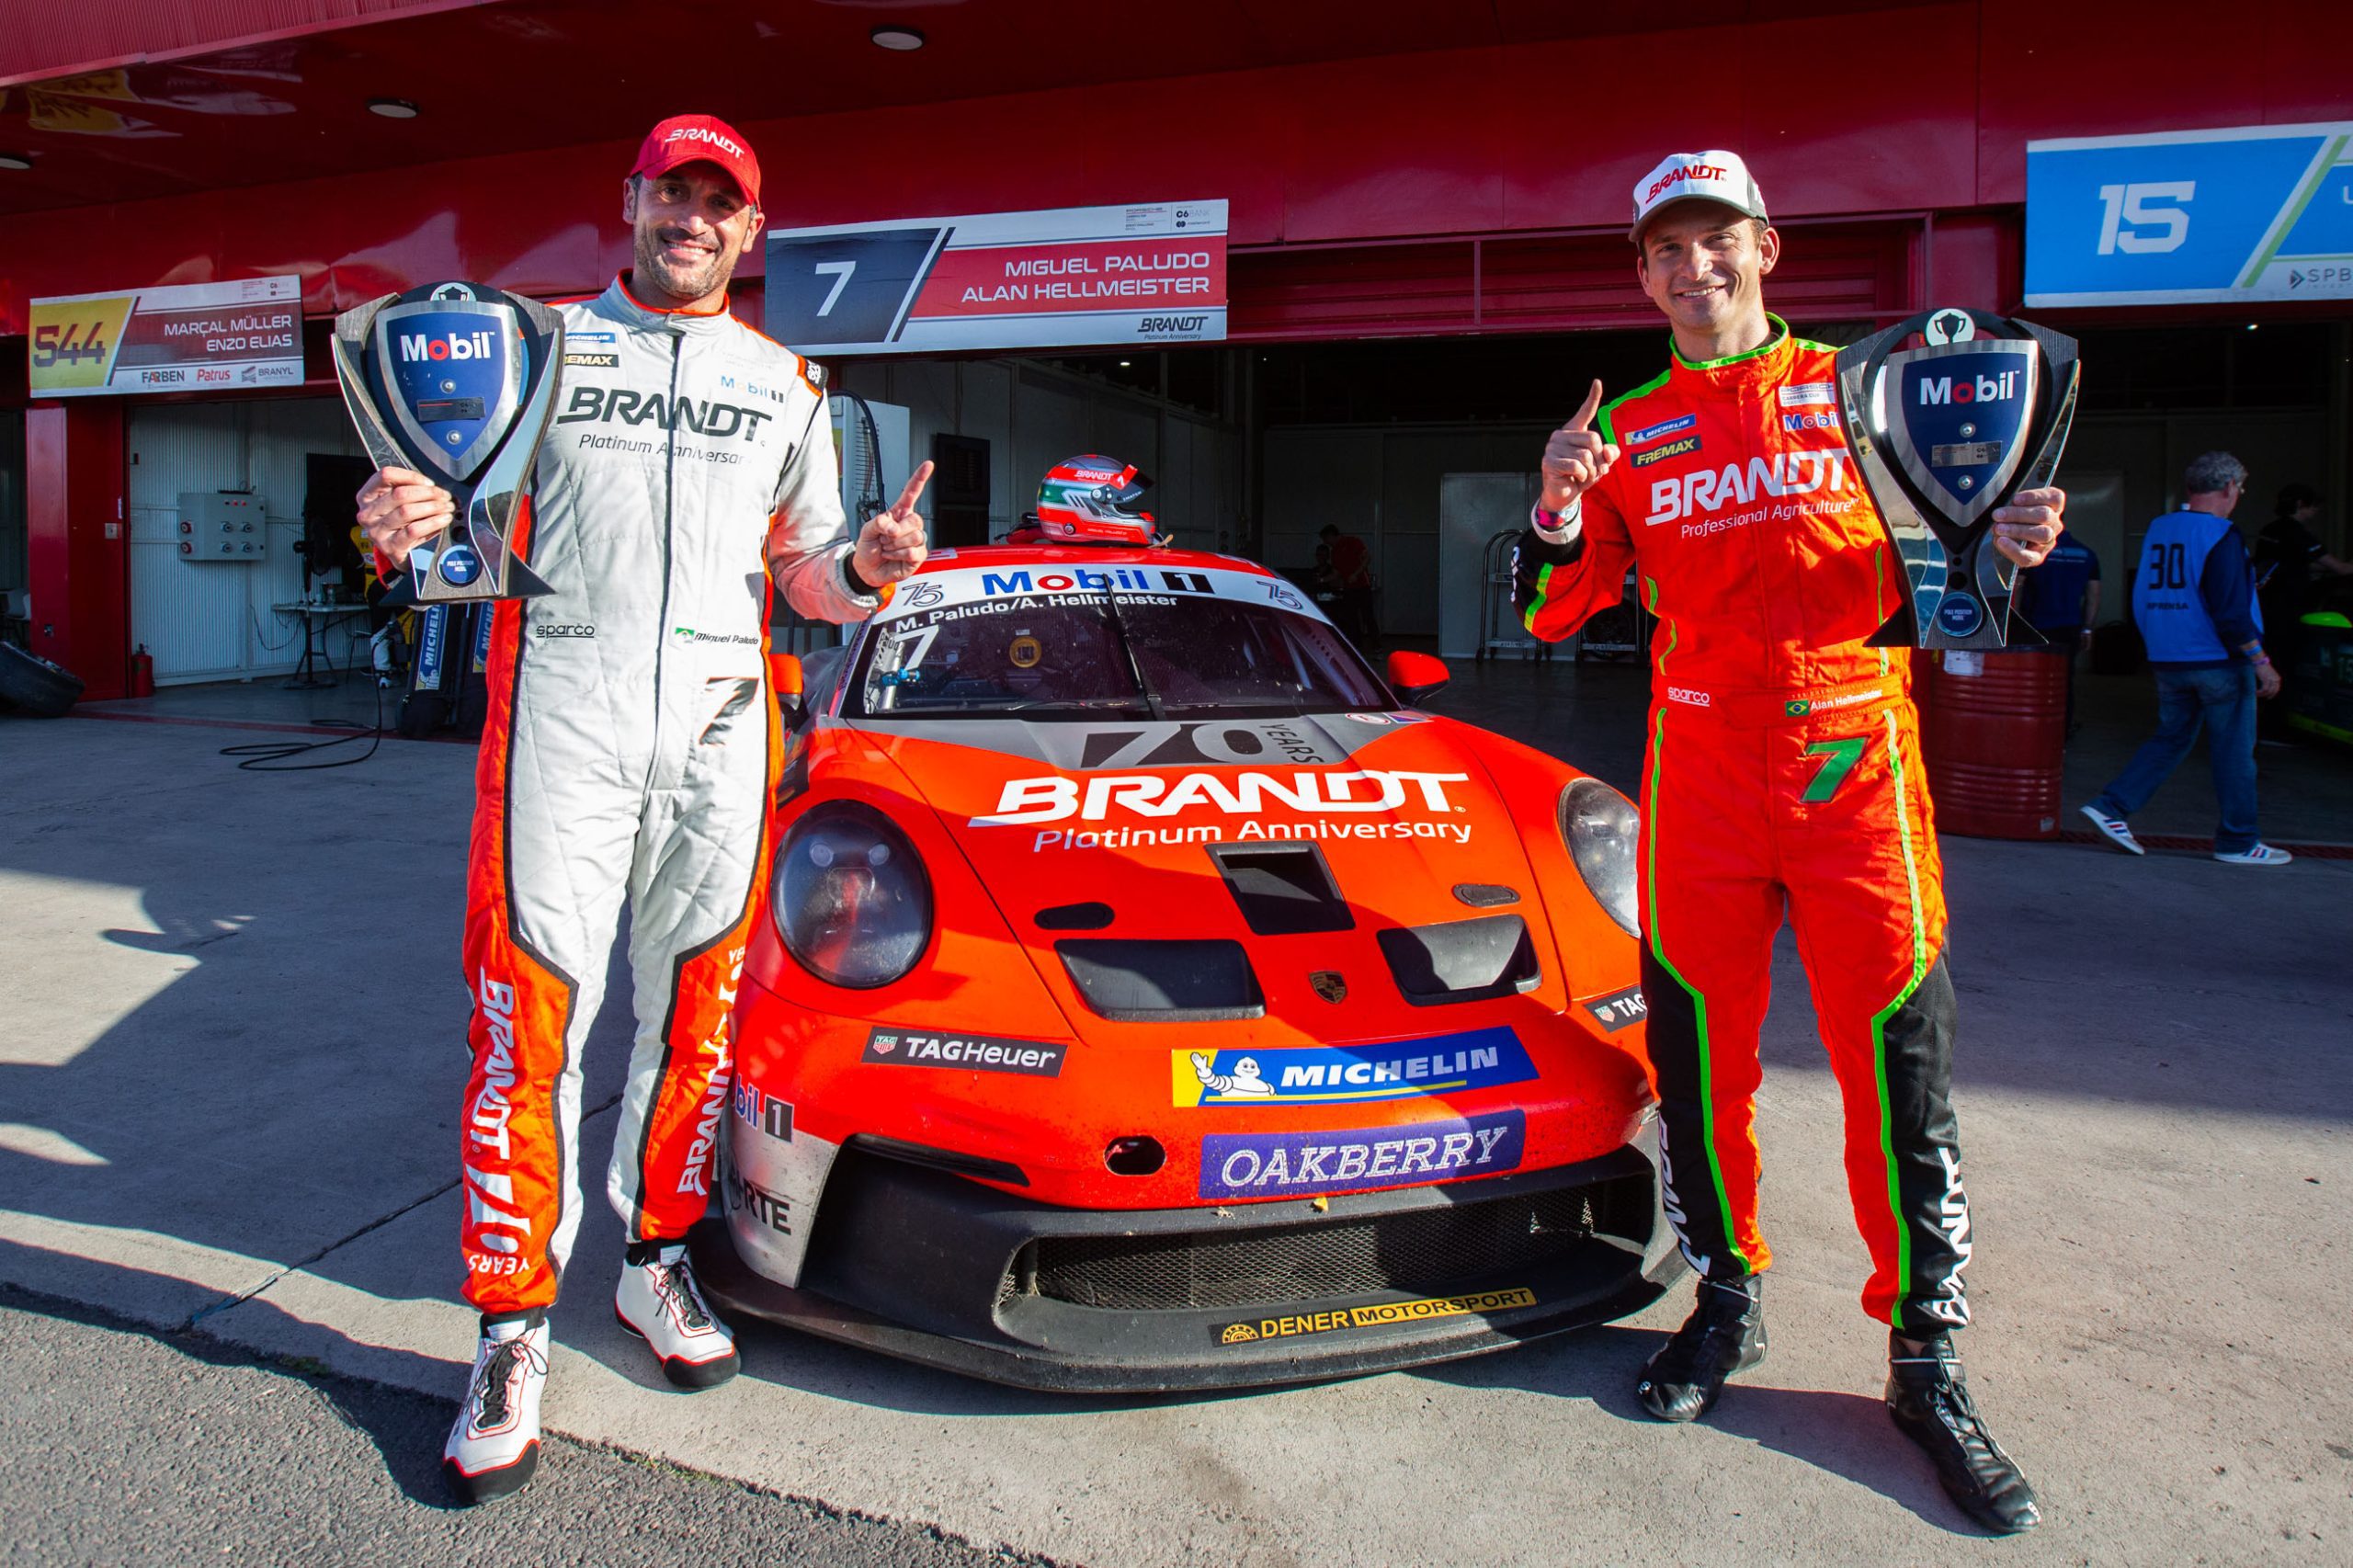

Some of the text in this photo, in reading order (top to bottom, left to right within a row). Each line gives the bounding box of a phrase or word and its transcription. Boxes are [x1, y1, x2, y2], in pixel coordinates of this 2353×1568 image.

[665, 129, 745, 158] BRANDT
[1646, 165, 1726, 204] BRANDT
[2097, 180, 2196, 256] 15
[1006, 251, 1210, 278] MIGUEL PALUDO
[815, 260, 856, 317] 7
[961, 277, 1210, 303] ALAN HELLMEISTER
[165, 314, 291, 337] MARÇAL MÜLLER
[1138, 316, 1209, 332] BRANDT
[33, 322, 107, 368] 544
[207, 334, 292, 352] ENZO ELIAS
[400, 332, 492, 362] Mobil
[142, 369, 185, 383] FARBEN
[197, 369, 231, 381] Patrus
[258, 367, 293, 377] BRANYL
[721, 375, 767, 397] Mobil
[1920, 370, 2014, 405] Mobil
[557, 386, 772, 441] BRANDT
[1646, 419, 1689, 438] MICHELIN
[579, 434, 653, 454] Platinum
[1637, 438, 1695, 466] FREMAX
[1074, 470, 1113, 481] BRANDT
[1645, 448, 1850, 527] BRANDT
[1681, 500, 1852, 539] Professional Agriculture
[2148, 543, 2185, 590] 30
[902, 582, 944, 608] 75
[982, 569, 1151, 597] Mobil
[1256, 581, 1303, 610] 75
[425, 604, 441, 666] MICHELI
[536, 624, 595, 638] sparco
[895, 617, 923, 633] M.
[894, 625, 939, 670] 7
[699, 676, 759, 745] 7
[1667, 686, 1710, 706] sparco
[1811, 700, 1833, 710] Alan
[1259, 724, 1324, 764] YEARS
[1800, 735, 1870, 802] 7
[967, 770, 1469, 827] BRANDT
[1033, 818, 1472, 853] Platinum Anniversary
[469, 967, 515, 1161] BRANDT
[1281, 1046, 1498, 1087] MICHELIN
[736, 1073, 760, 1131] bil
[1221, 1125, 1509, 1187] OAKBERRY
[469, 1254, 530, 1276] YEARS
[1260, 1289, 1530, 1338] DENER MOTORSPORT
